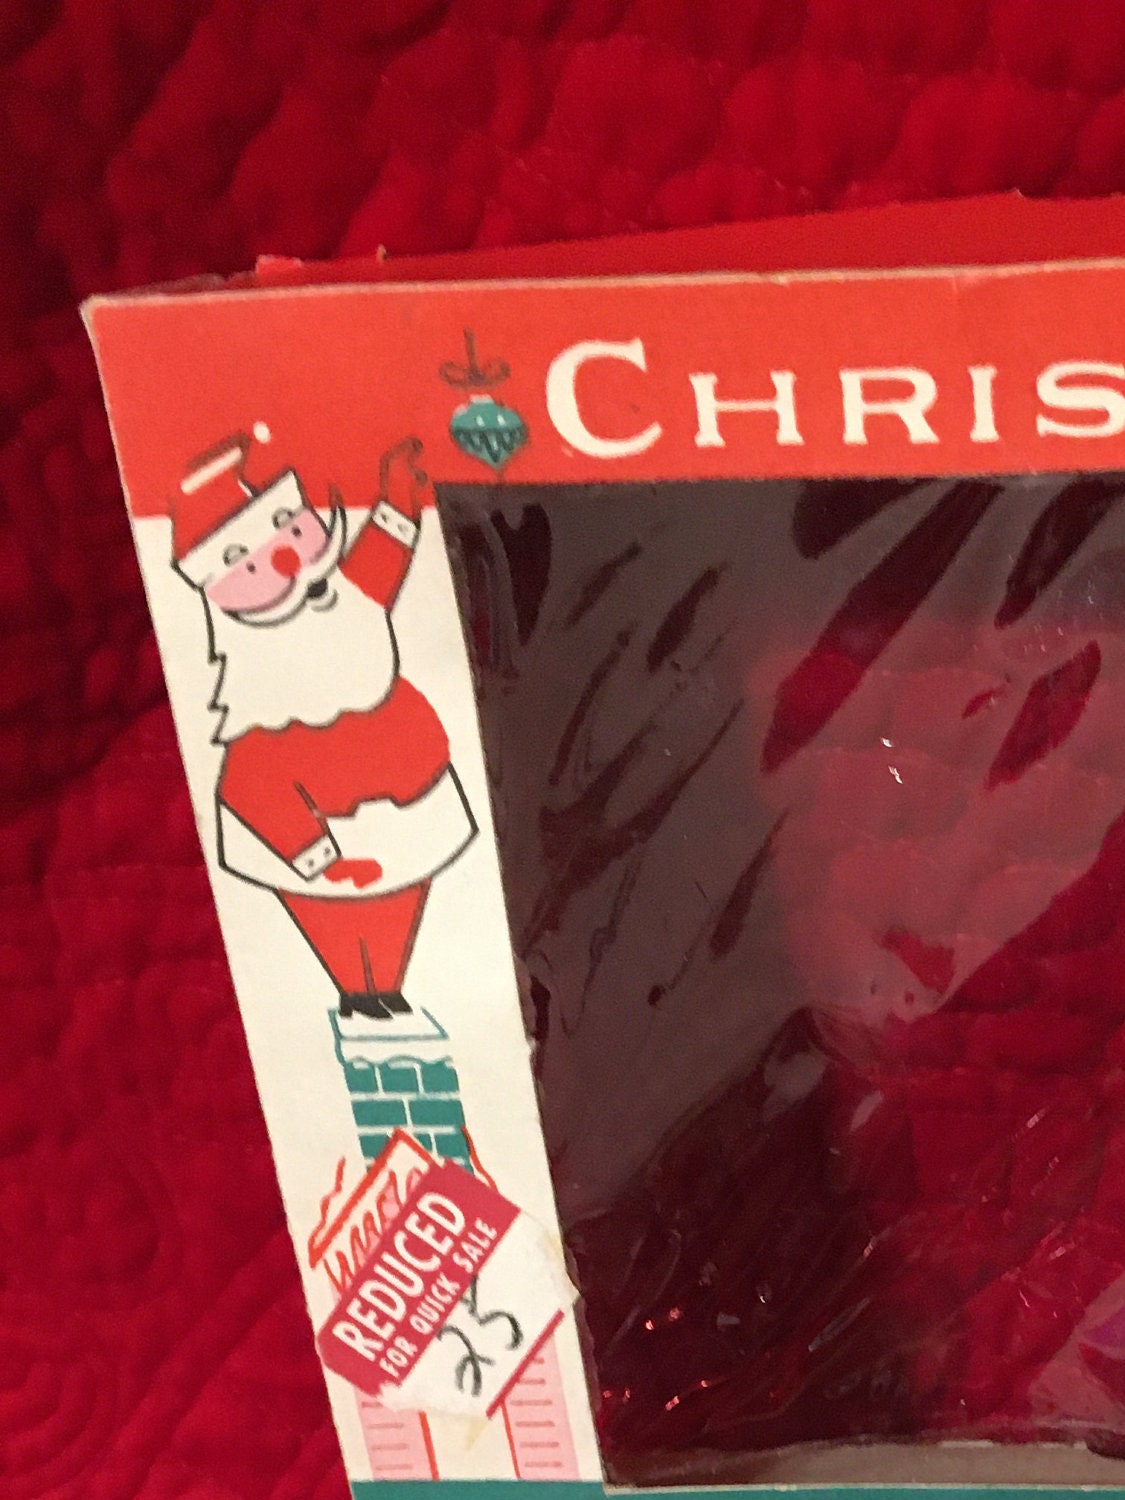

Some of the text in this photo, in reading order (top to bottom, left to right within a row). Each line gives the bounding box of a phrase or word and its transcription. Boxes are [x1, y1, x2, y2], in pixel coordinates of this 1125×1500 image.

[332, 1191, 466, 1362] REDUCED
[379, 1217, 498, 1378] FOR QUICK SALE
[436, 1274, 524, 1398] 25
